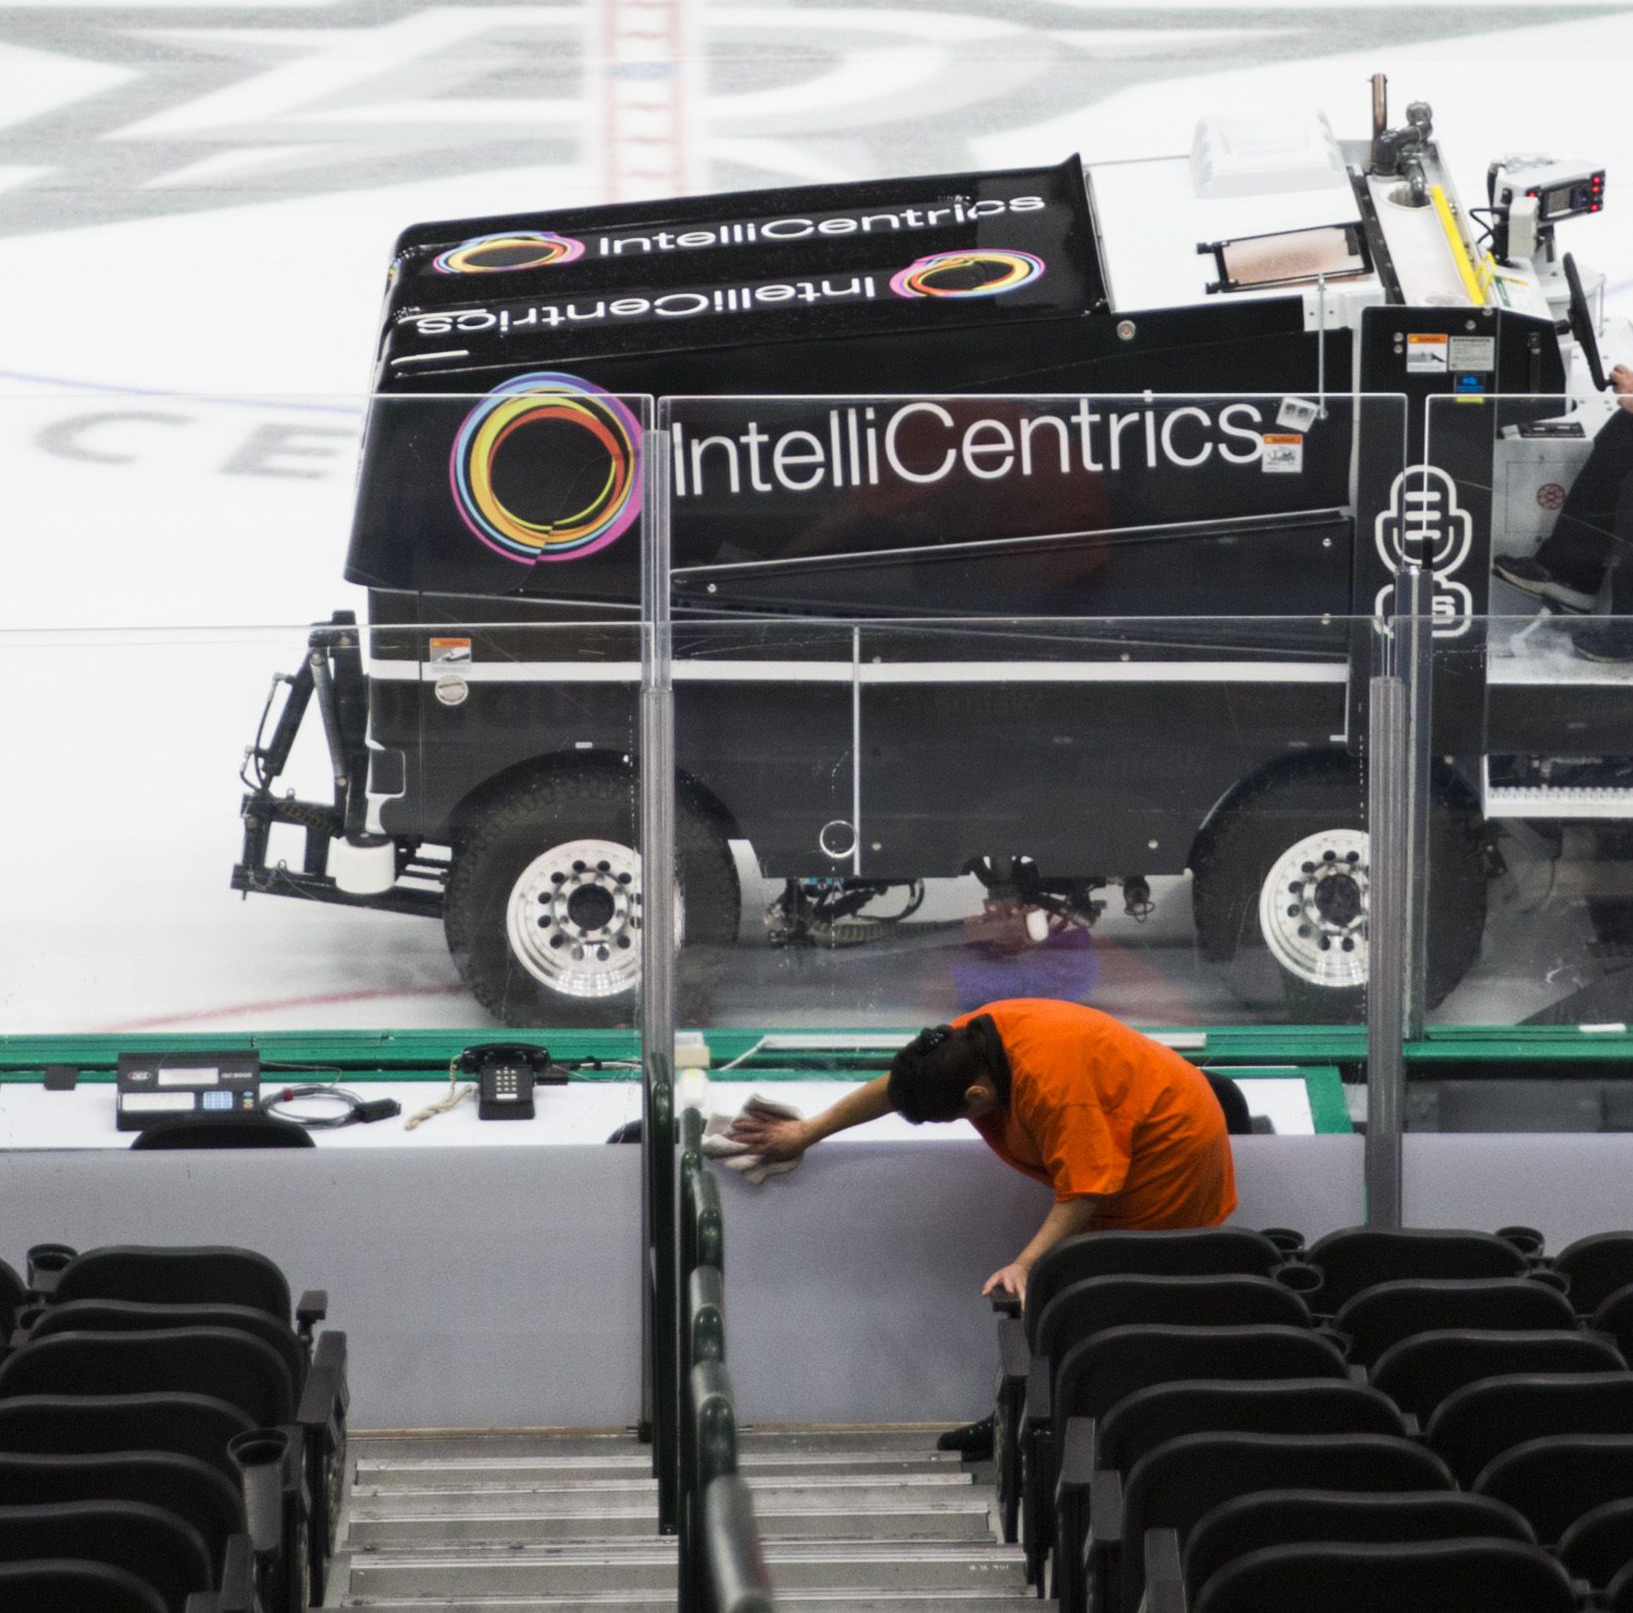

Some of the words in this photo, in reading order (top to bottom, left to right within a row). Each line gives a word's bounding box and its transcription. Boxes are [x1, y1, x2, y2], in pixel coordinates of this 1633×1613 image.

[599, 194, 1046, 256] IntelliCentrics
[415, 277, 875, 335] IntelliCentrics
[669, 398, 1264, 496] IntelliCentrics
